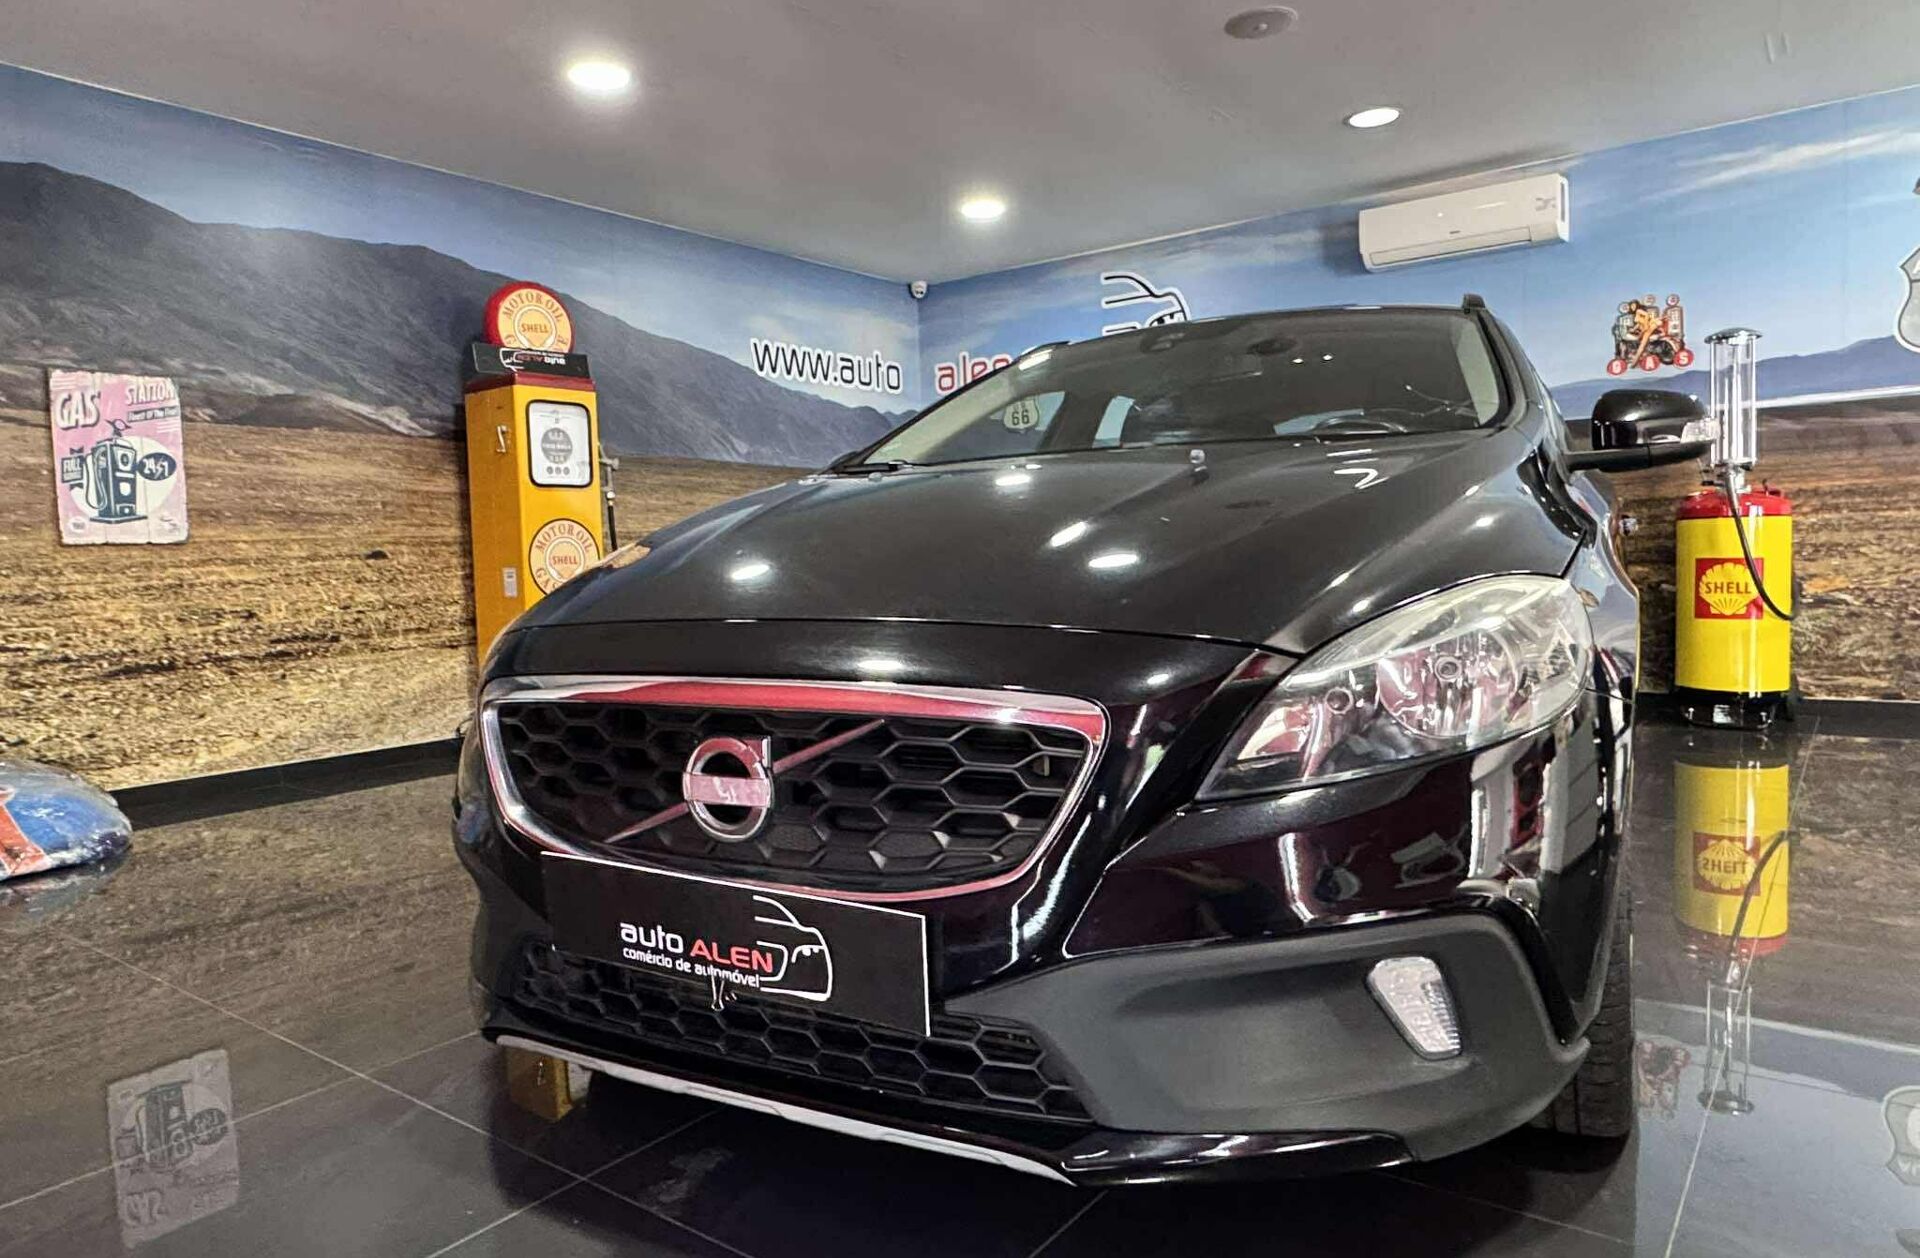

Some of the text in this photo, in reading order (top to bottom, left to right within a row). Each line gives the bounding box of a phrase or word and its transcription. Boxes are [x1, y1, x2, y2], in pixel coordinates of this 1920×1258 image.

[503, 291, 564, 322] MOTOR OIL
[521, 323, 549, 334] SHELL
[753, 341, 901, 391] www.auto
[55, 390, 102, 430] GAS
[1011, 408, 1030, 426] 66
[63, 457, 82, 473] FULL
[535, 522, 593, 553] MOTOR OIL
[552, 555, 577, 565] SHELL
[1705, 581, 1752, 595] SHELL
[620, 922, 772, 973] auto ALEN
[622, 947, 673, 968] comércio
[675, 957, 692, 973] de
